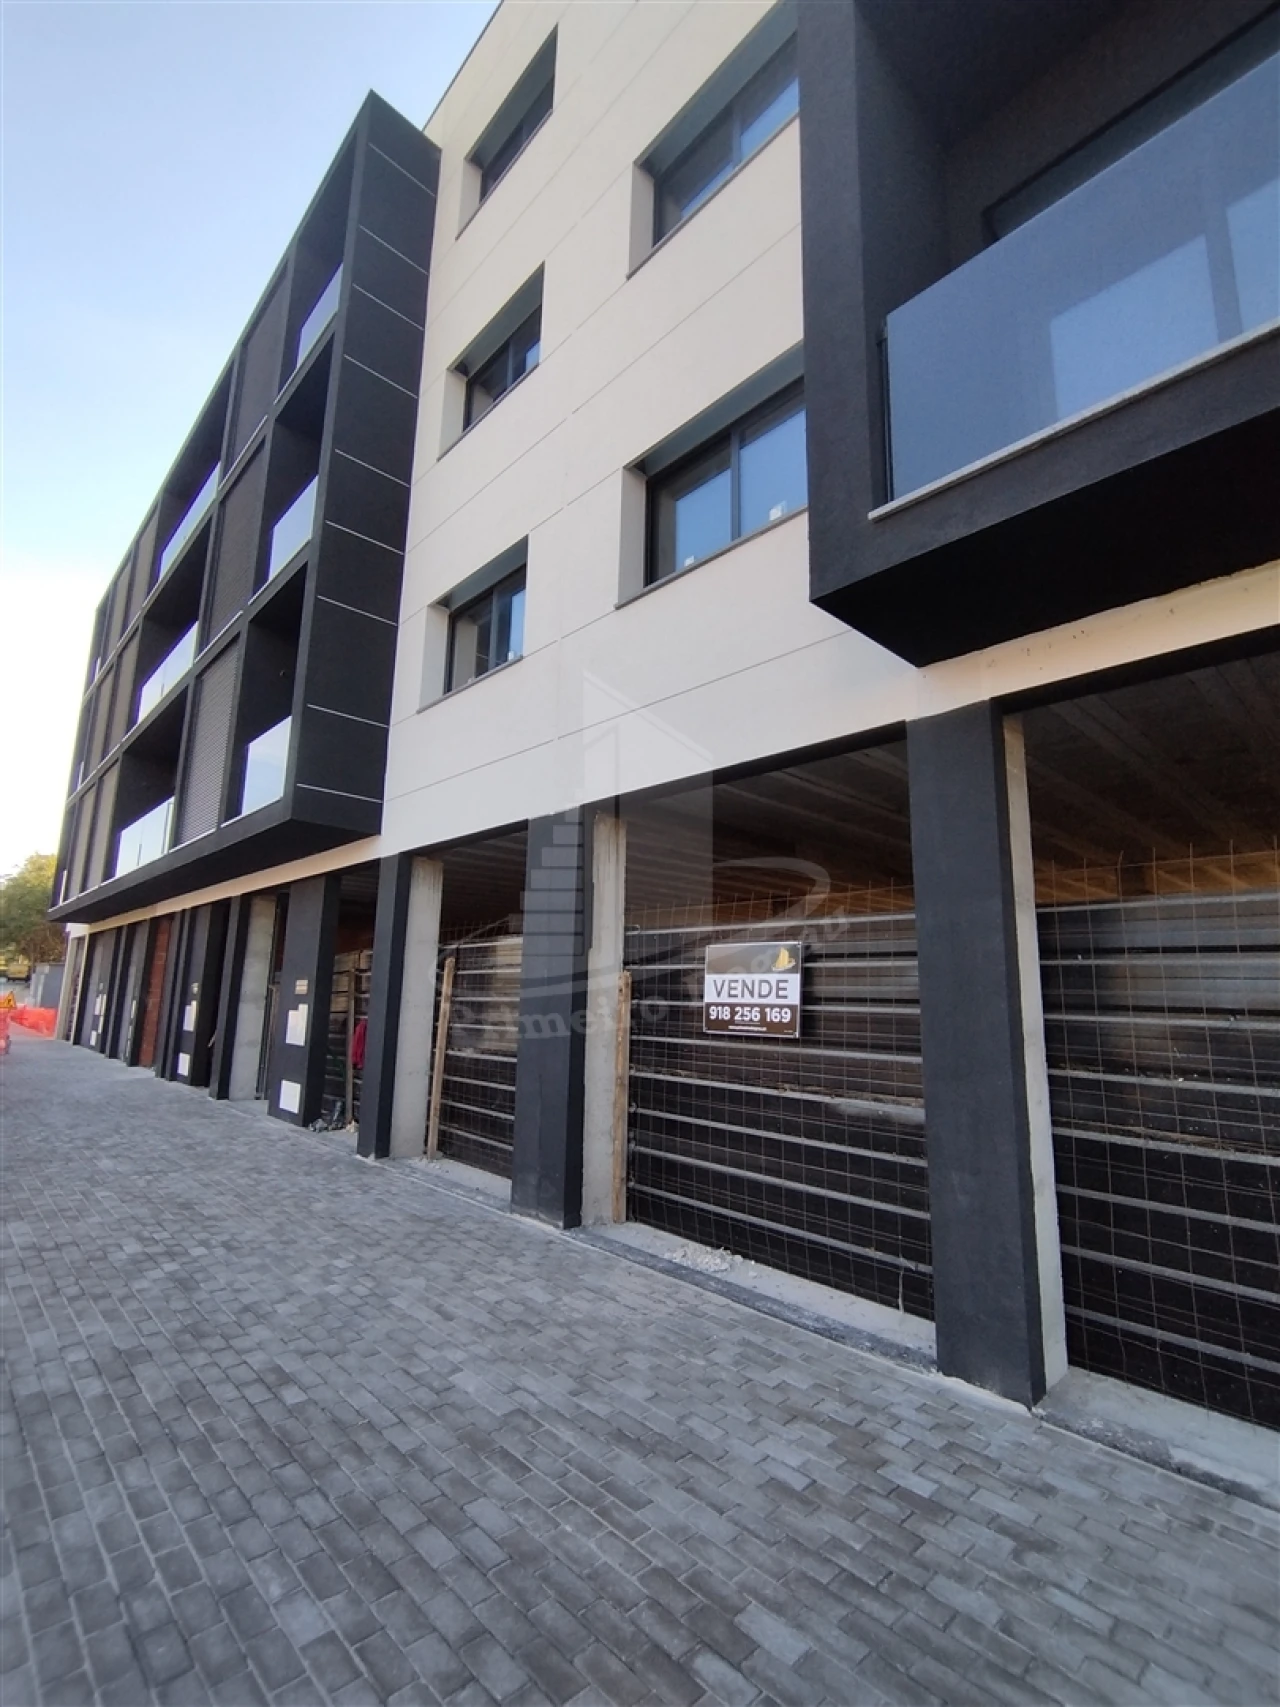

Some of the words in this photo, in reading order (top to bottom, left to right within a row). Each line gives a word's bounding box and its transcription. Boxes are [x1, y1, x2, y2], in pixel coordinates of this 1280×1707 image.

[713, 979, 790, 1000] VENDE
[709, 1005, 731, 1020] 918
[734, 1006, 761, 1022] 256
[764, 1007, 792, 1023] 169
